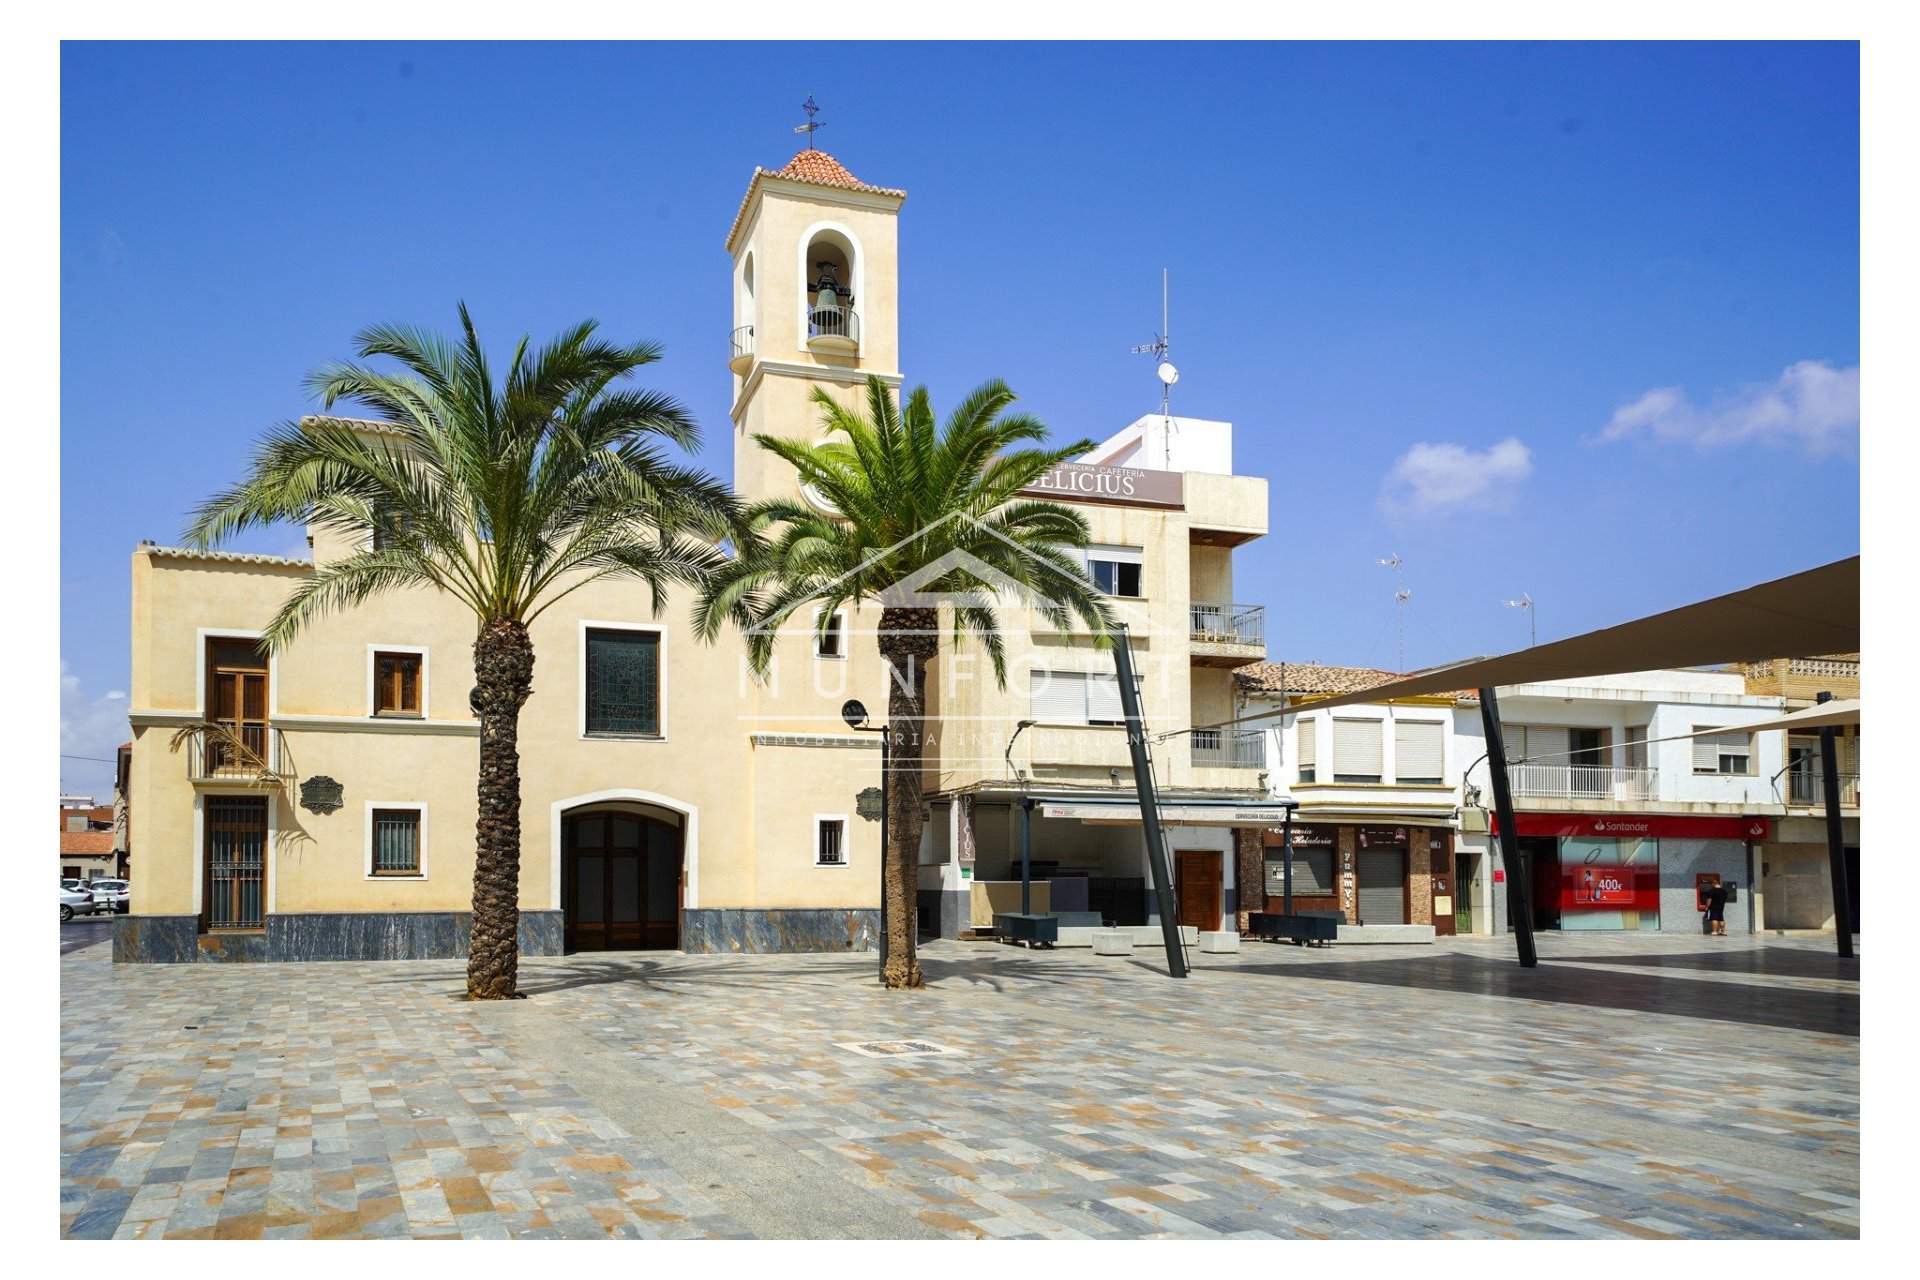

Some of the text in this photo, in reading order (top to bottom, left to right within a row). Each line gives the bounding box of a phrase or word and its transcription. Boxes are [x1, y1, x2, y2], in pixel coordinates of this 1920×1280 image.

[1100, 467, 1145, 478] CAFETERÍA
[1606, 821, 1648, 832] Santander
[1598, 879, 1623, 890] 400€
